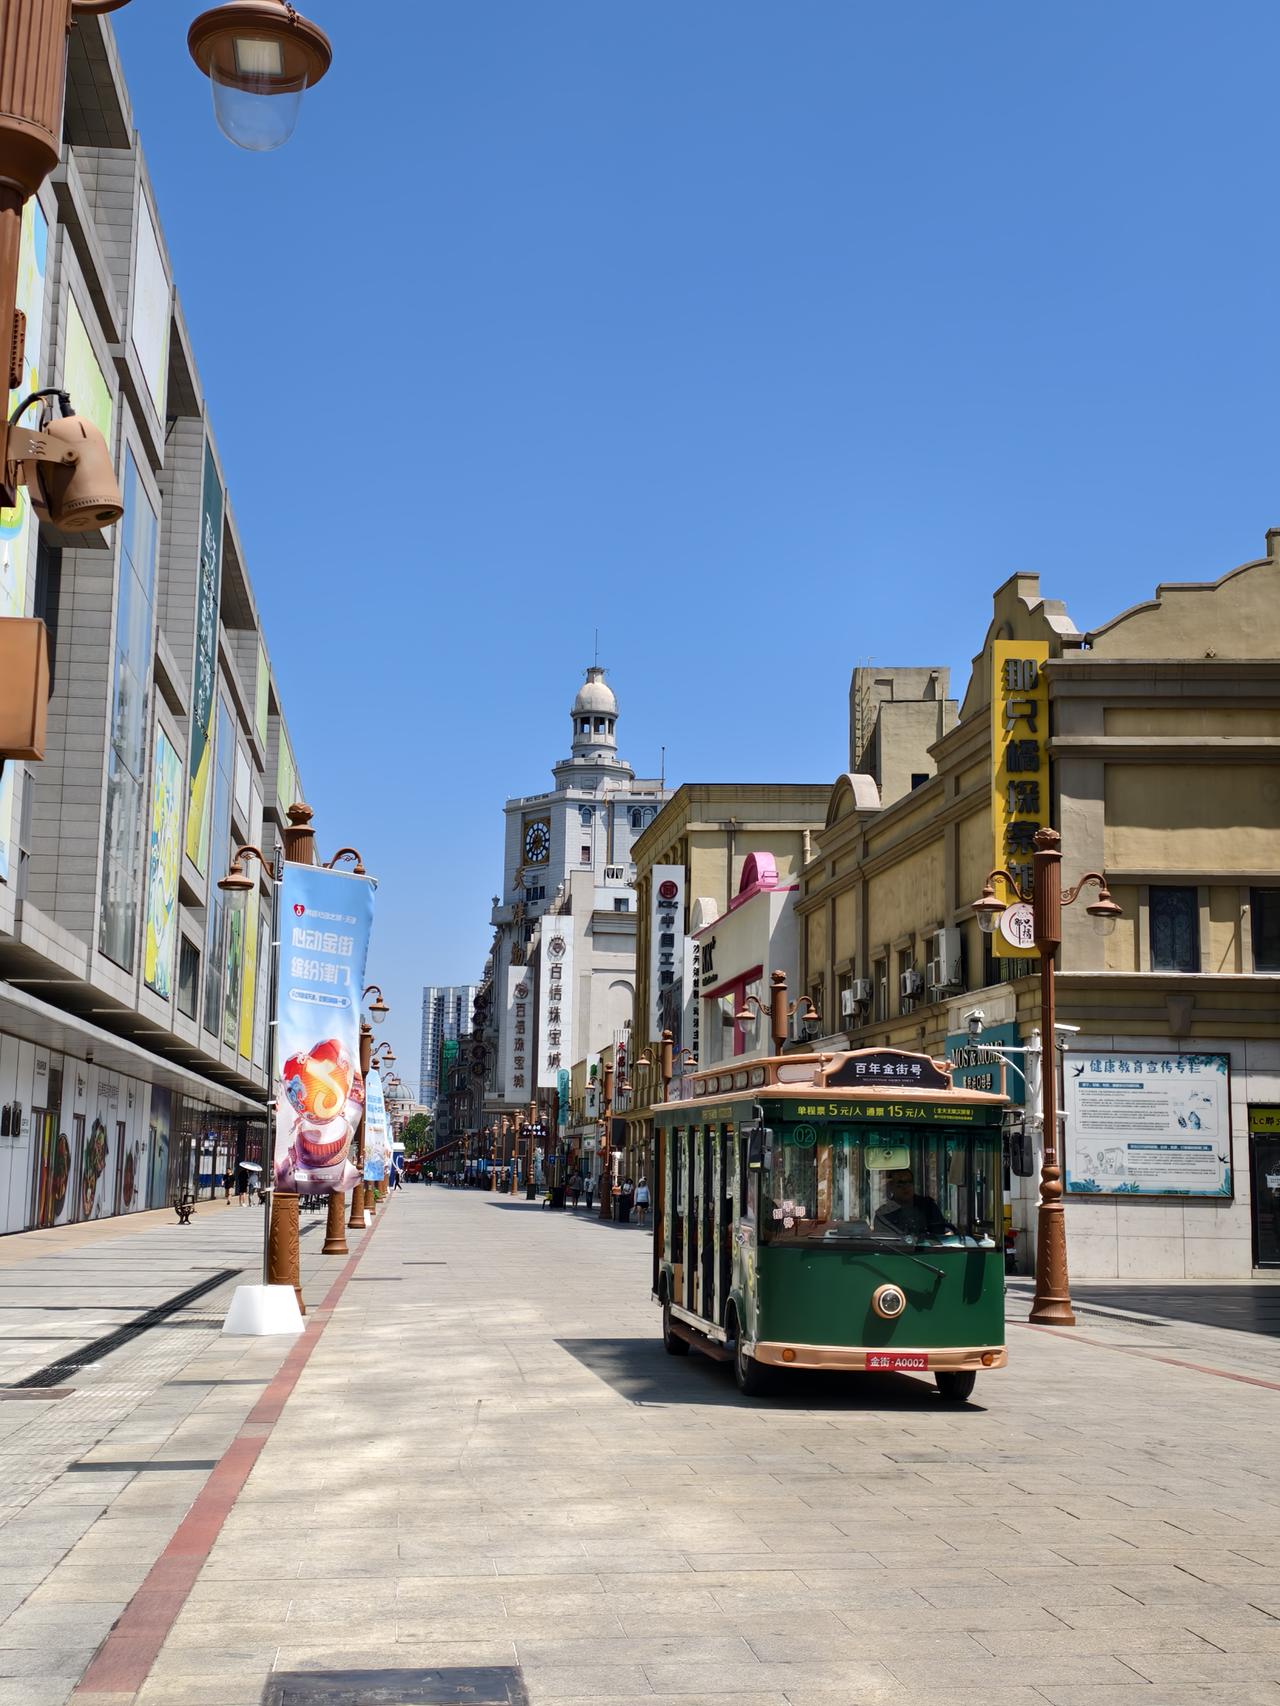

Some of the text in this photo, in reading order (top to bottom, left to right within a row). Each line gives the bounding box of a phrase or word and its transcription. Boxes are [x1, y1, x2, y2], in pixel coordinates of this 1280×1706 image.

[292, 927, 354, 956] 心动金街
[291, 956, 351, 986] 缤纷津门
[547, 962, 563, 1069] 百信珠宝城
[512, 1003, 526, 1088] 百信珠宝城
[969, 1051, 976, 1066] &
[855, 1062, 922, 1076] 百年金街号
[1090, 1059, 1201, 1074] 健康教育宣传专栏
[797, 1106, 826, 1116] 单程票
[829, 1104, 838, 1116] 5
[840, 1106, 862, 1116] 元/人
[888, 1105, 903, 1117] 15
[905, 1108, 927, 1118] 元/人
[796, 1129, 814, 1143] 02
